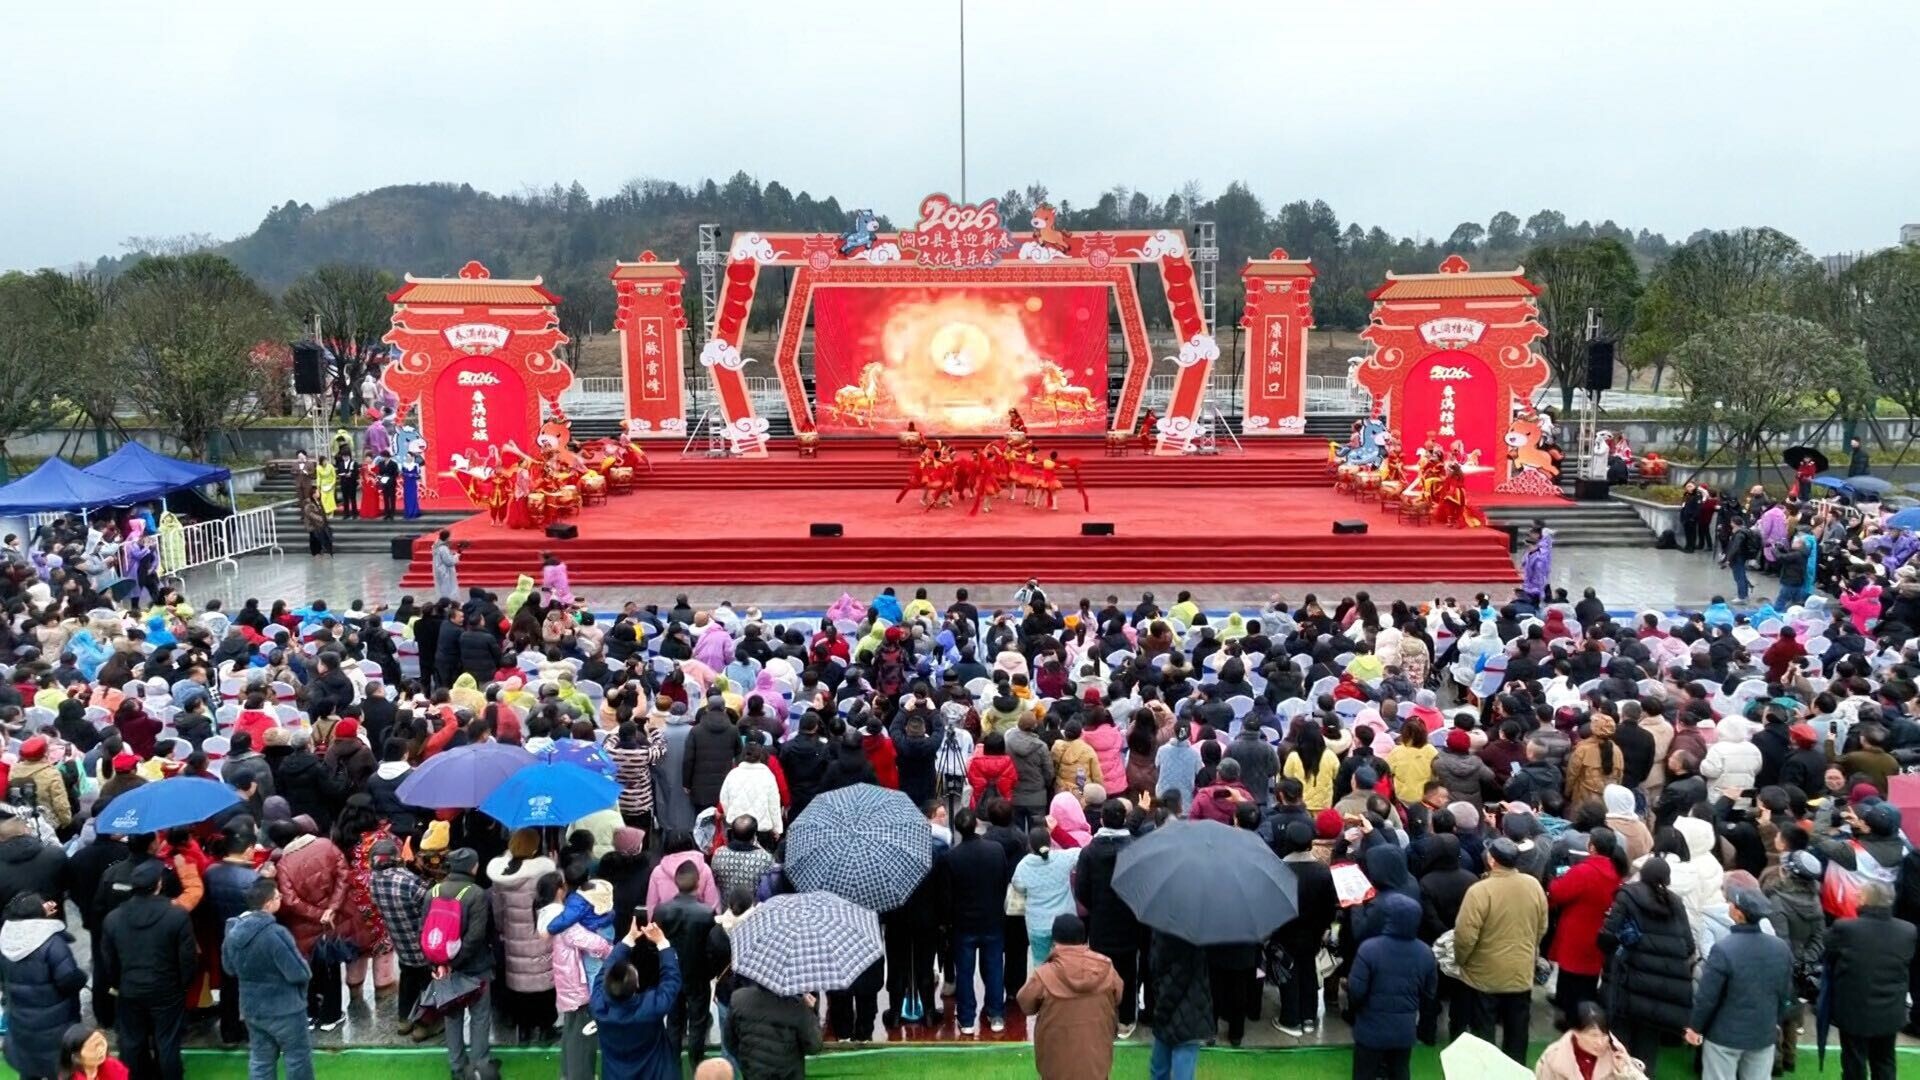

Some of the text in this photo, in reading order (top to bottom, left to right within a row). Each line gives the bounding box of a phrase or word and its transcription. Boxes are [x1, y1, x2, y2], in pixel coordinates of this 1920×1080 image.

[919, 199, 998, 232] 2026
[901, 230, 1014, 249] 洞口县喜迎新春
[1267, 321, 1284, 393] 康养洞口
